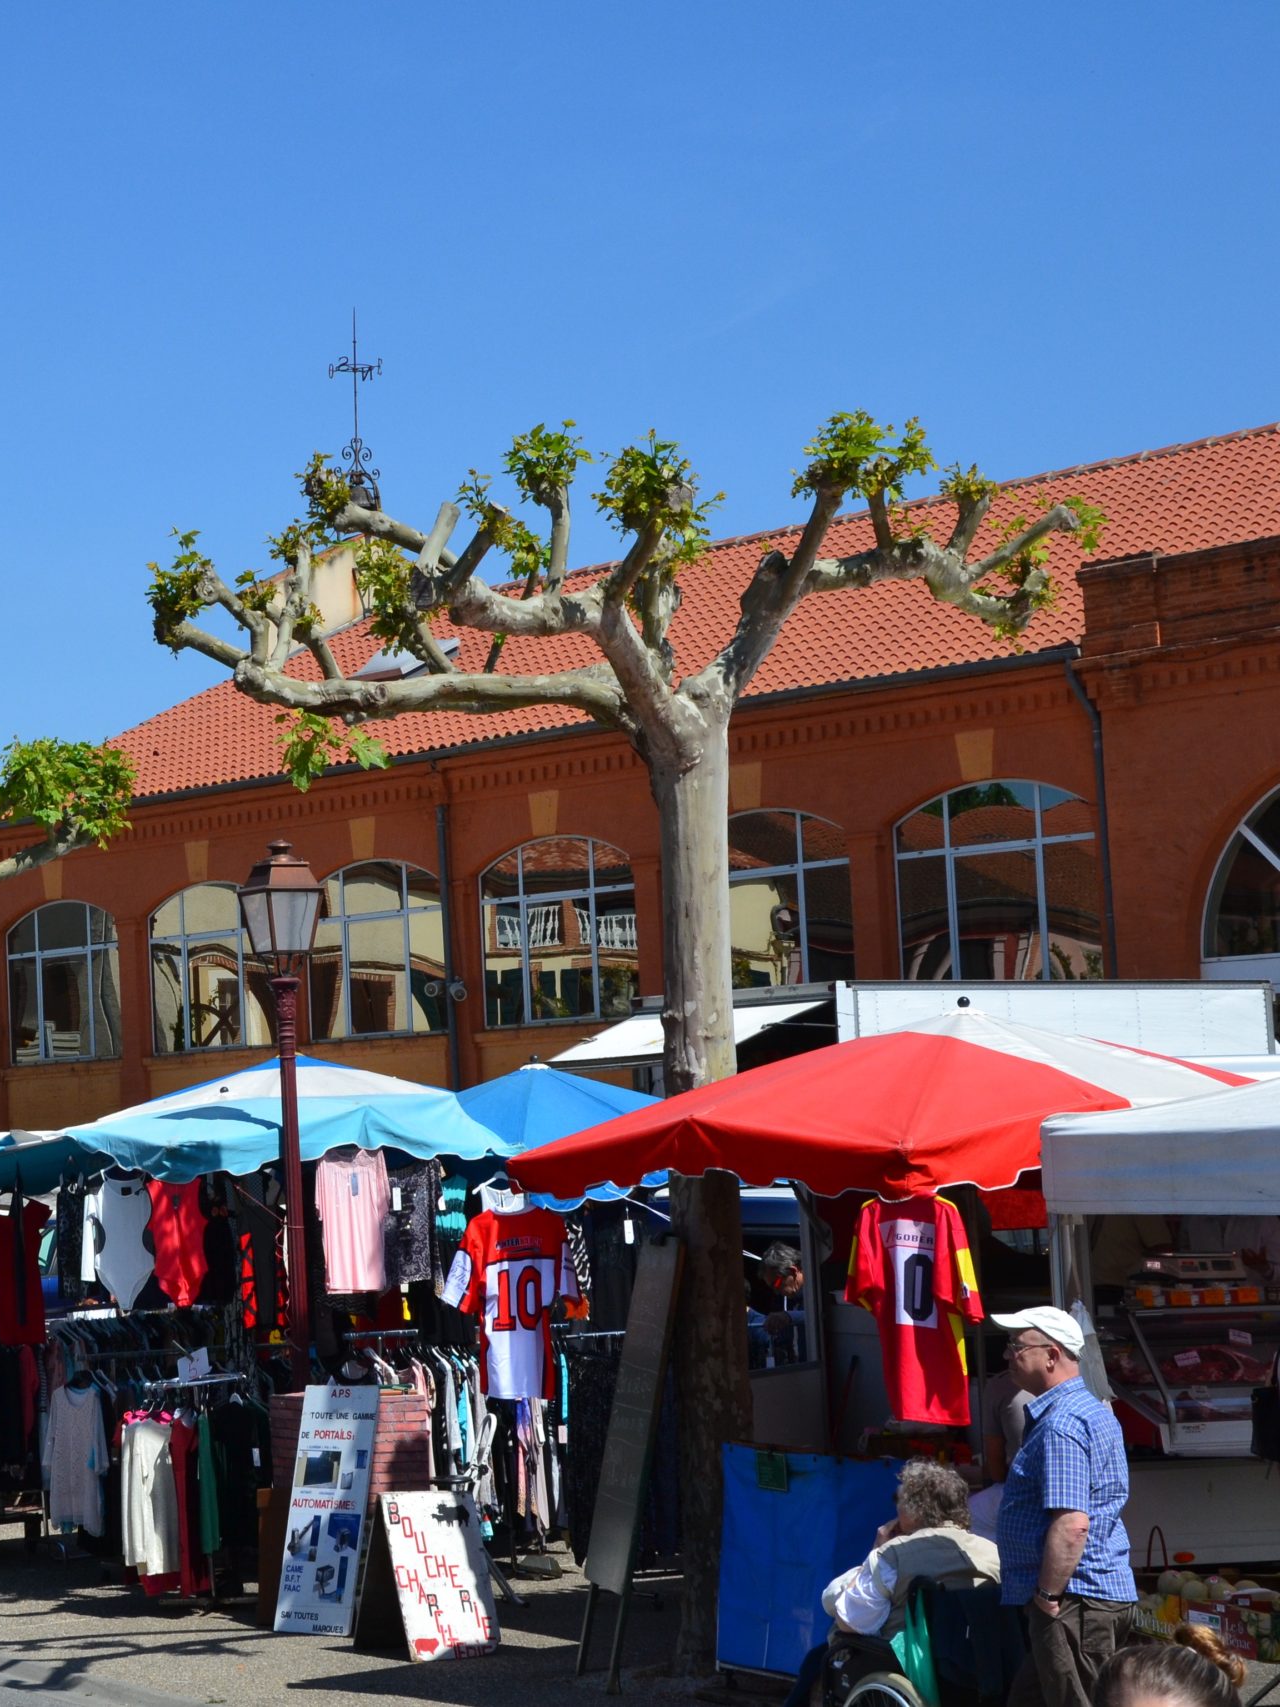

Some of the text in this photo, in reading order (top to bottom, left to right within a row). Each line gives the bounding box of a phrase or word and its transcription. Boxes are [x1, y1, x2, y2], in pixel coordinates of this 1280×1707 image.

[492, 1265, 542, 1331] 10
[311, 1411, 376, 1421] TOUTE UNE GAMME
[301, 1431, 310, 1439] DE
[285, 1565, 304, 1574] CAME
[283, 1584, 301, 1593] FAAC
[281, 1610, 319, 1621] SAV TOUTES
[312, 1624, 344, 1634] MARQUES
